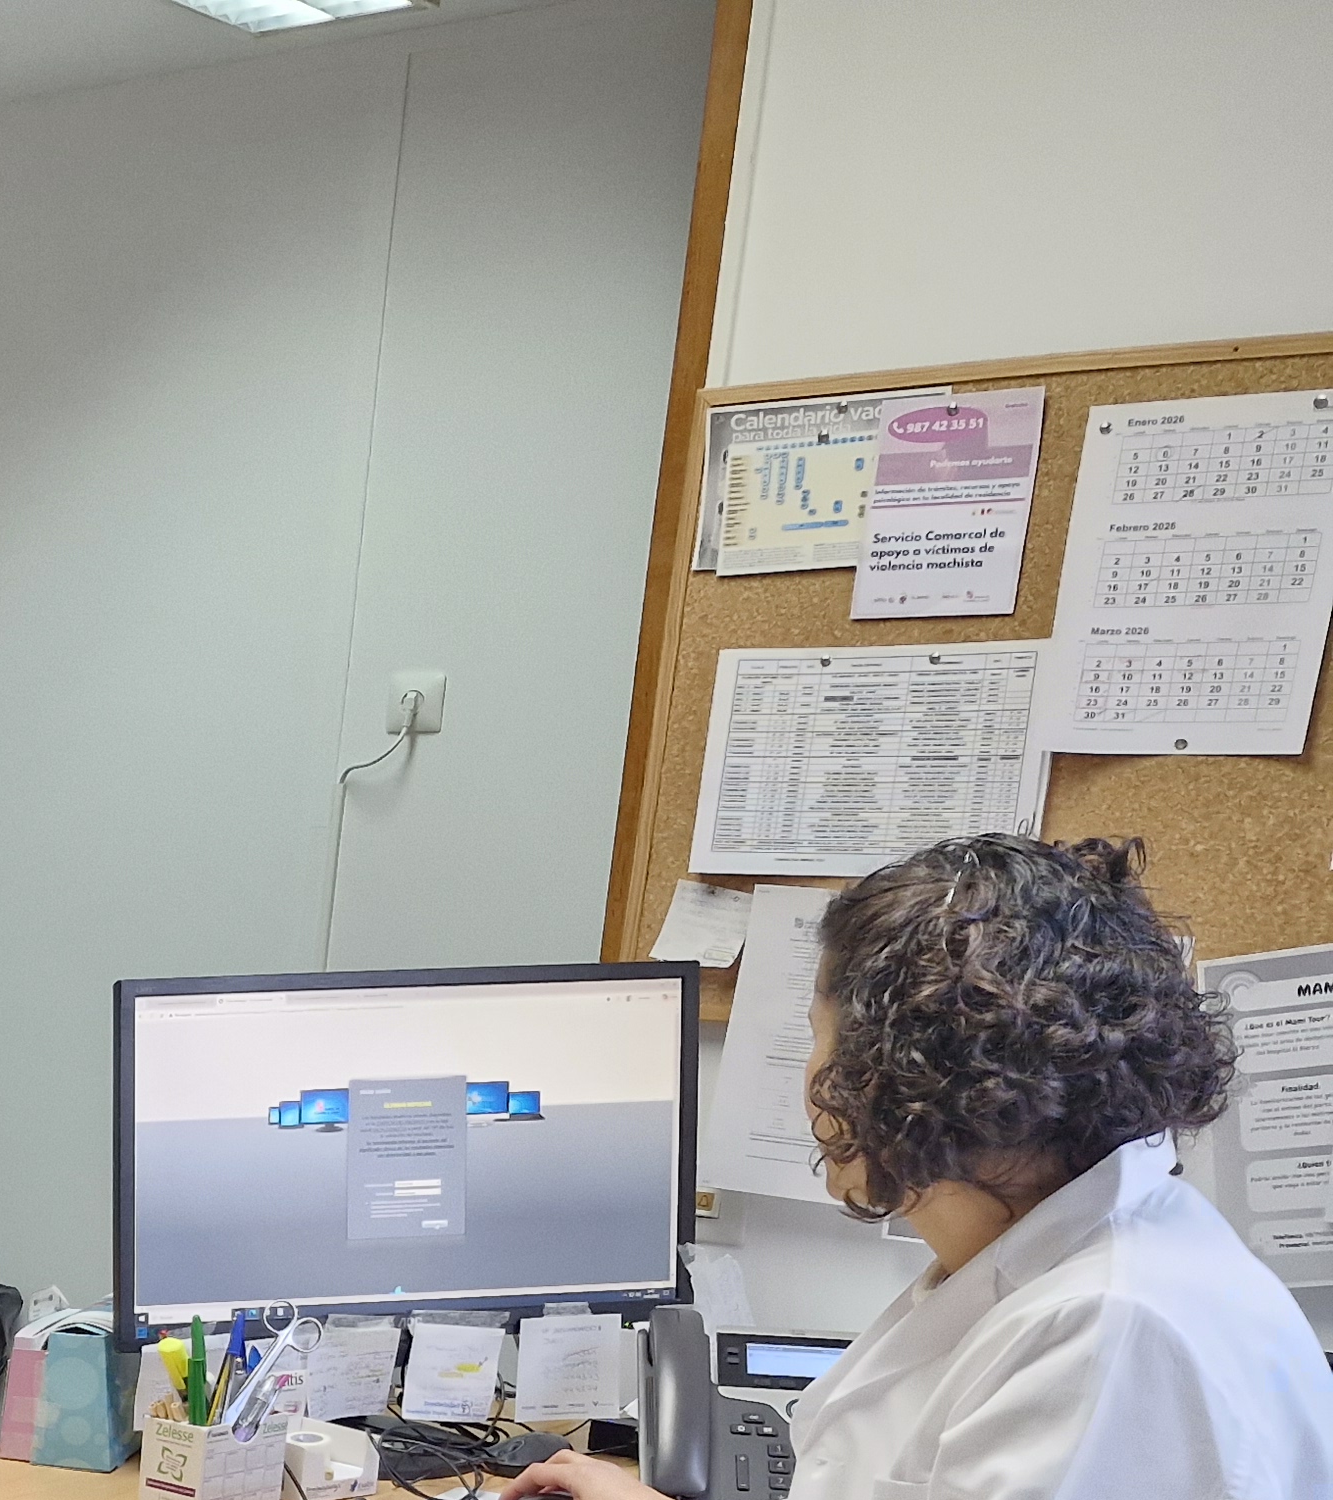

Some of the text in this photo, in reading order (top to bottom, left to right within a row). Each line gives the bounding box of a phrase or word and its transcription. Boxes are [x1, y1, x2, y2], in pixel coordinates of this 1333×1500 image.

[730, 406, 846, 431] Calendario
[906, 418, 984, 434] 987 42 35 51
[1127, 415, 1185, 426] Enero 2026
[873, 527, 1006, 544] Servicio Comarcal de
[1109, 523, 1150, 532] Febrero
[871, 543, 994, 559] apoyo a víctimas de
[870, 558, 983, 571] violencia machista
[1091, 627, 1149, 636] Marzo 2026
[156, 1422, 194, 1443] Zelesse
